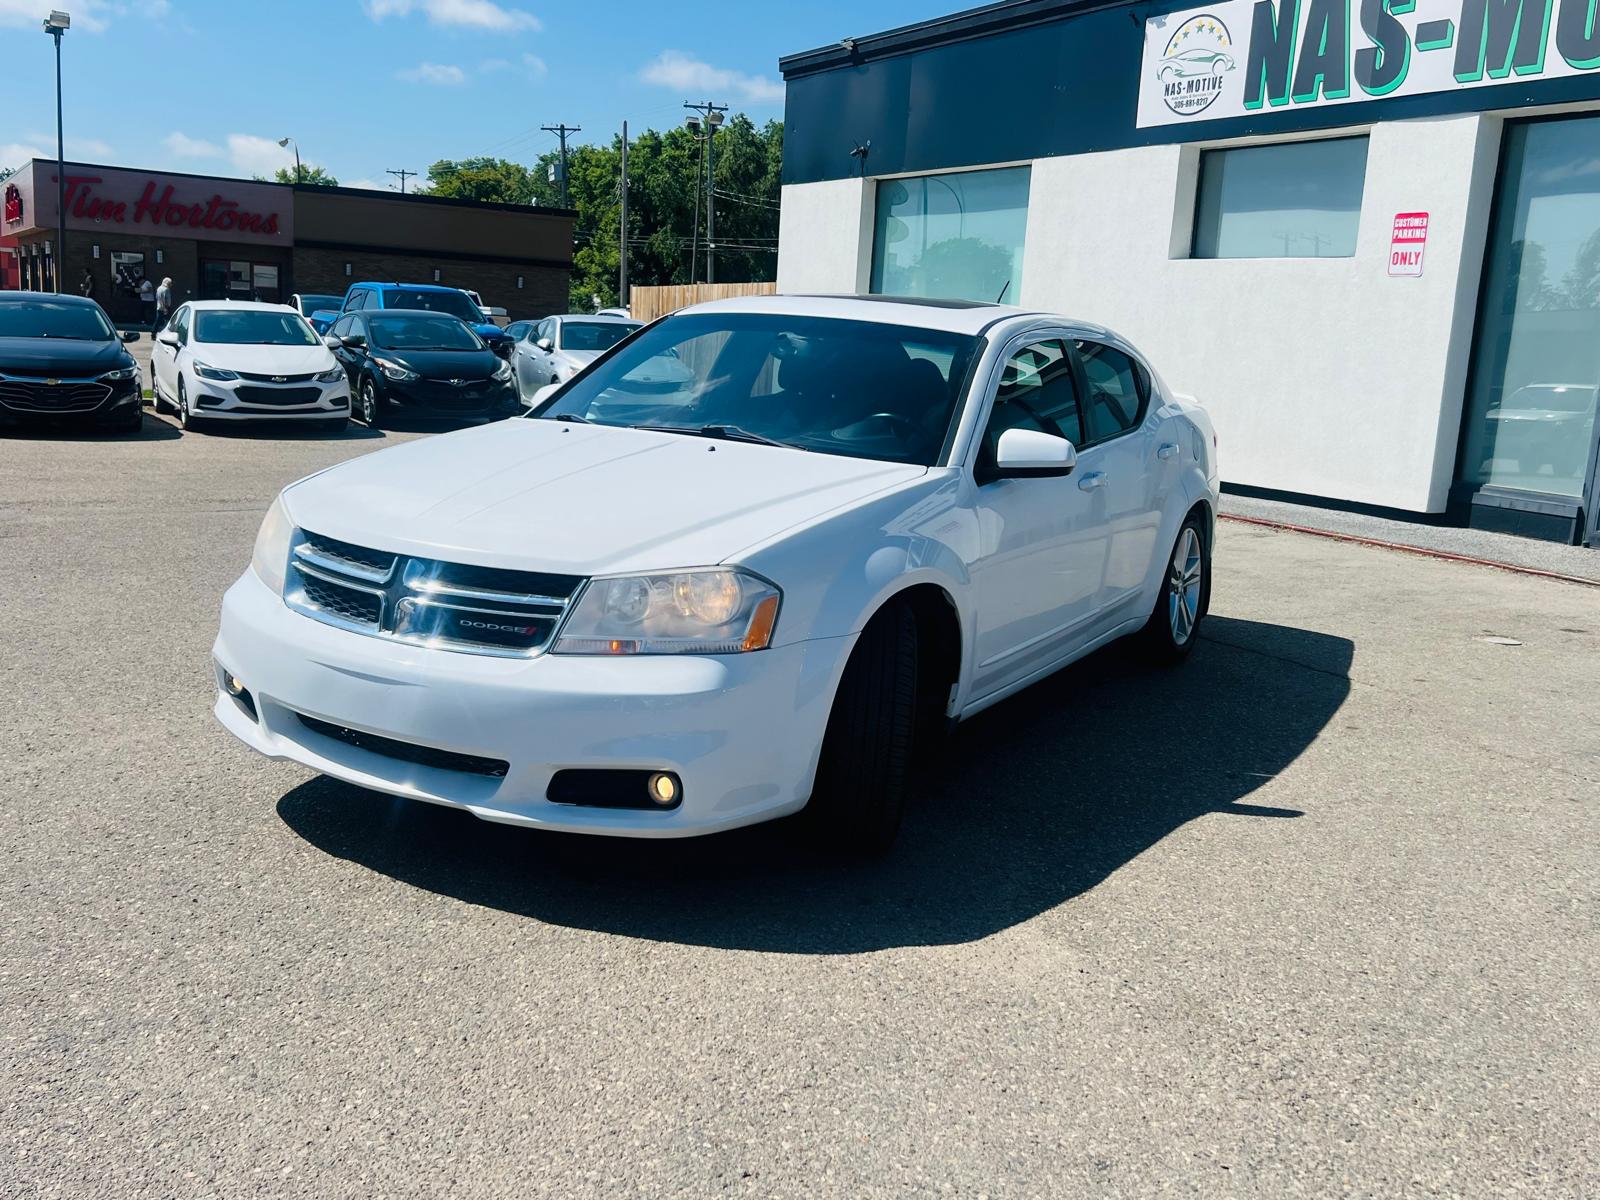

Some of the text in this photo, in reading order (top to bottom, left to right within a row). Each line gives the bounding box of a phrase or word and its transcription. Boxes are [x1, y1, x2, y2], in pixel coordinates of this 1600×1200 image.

[1164, 76, 1223, 97] NAS-MOTIVE
[52, 176, 279, 234] Tim Hortons
[1395, 218, 1427, 228] CUSTOMER
[1393, 228, 1426, 239] PARKING
[1392, 251, 1421, 266] ONLY
[460, 619, 528, 634] DODGE
